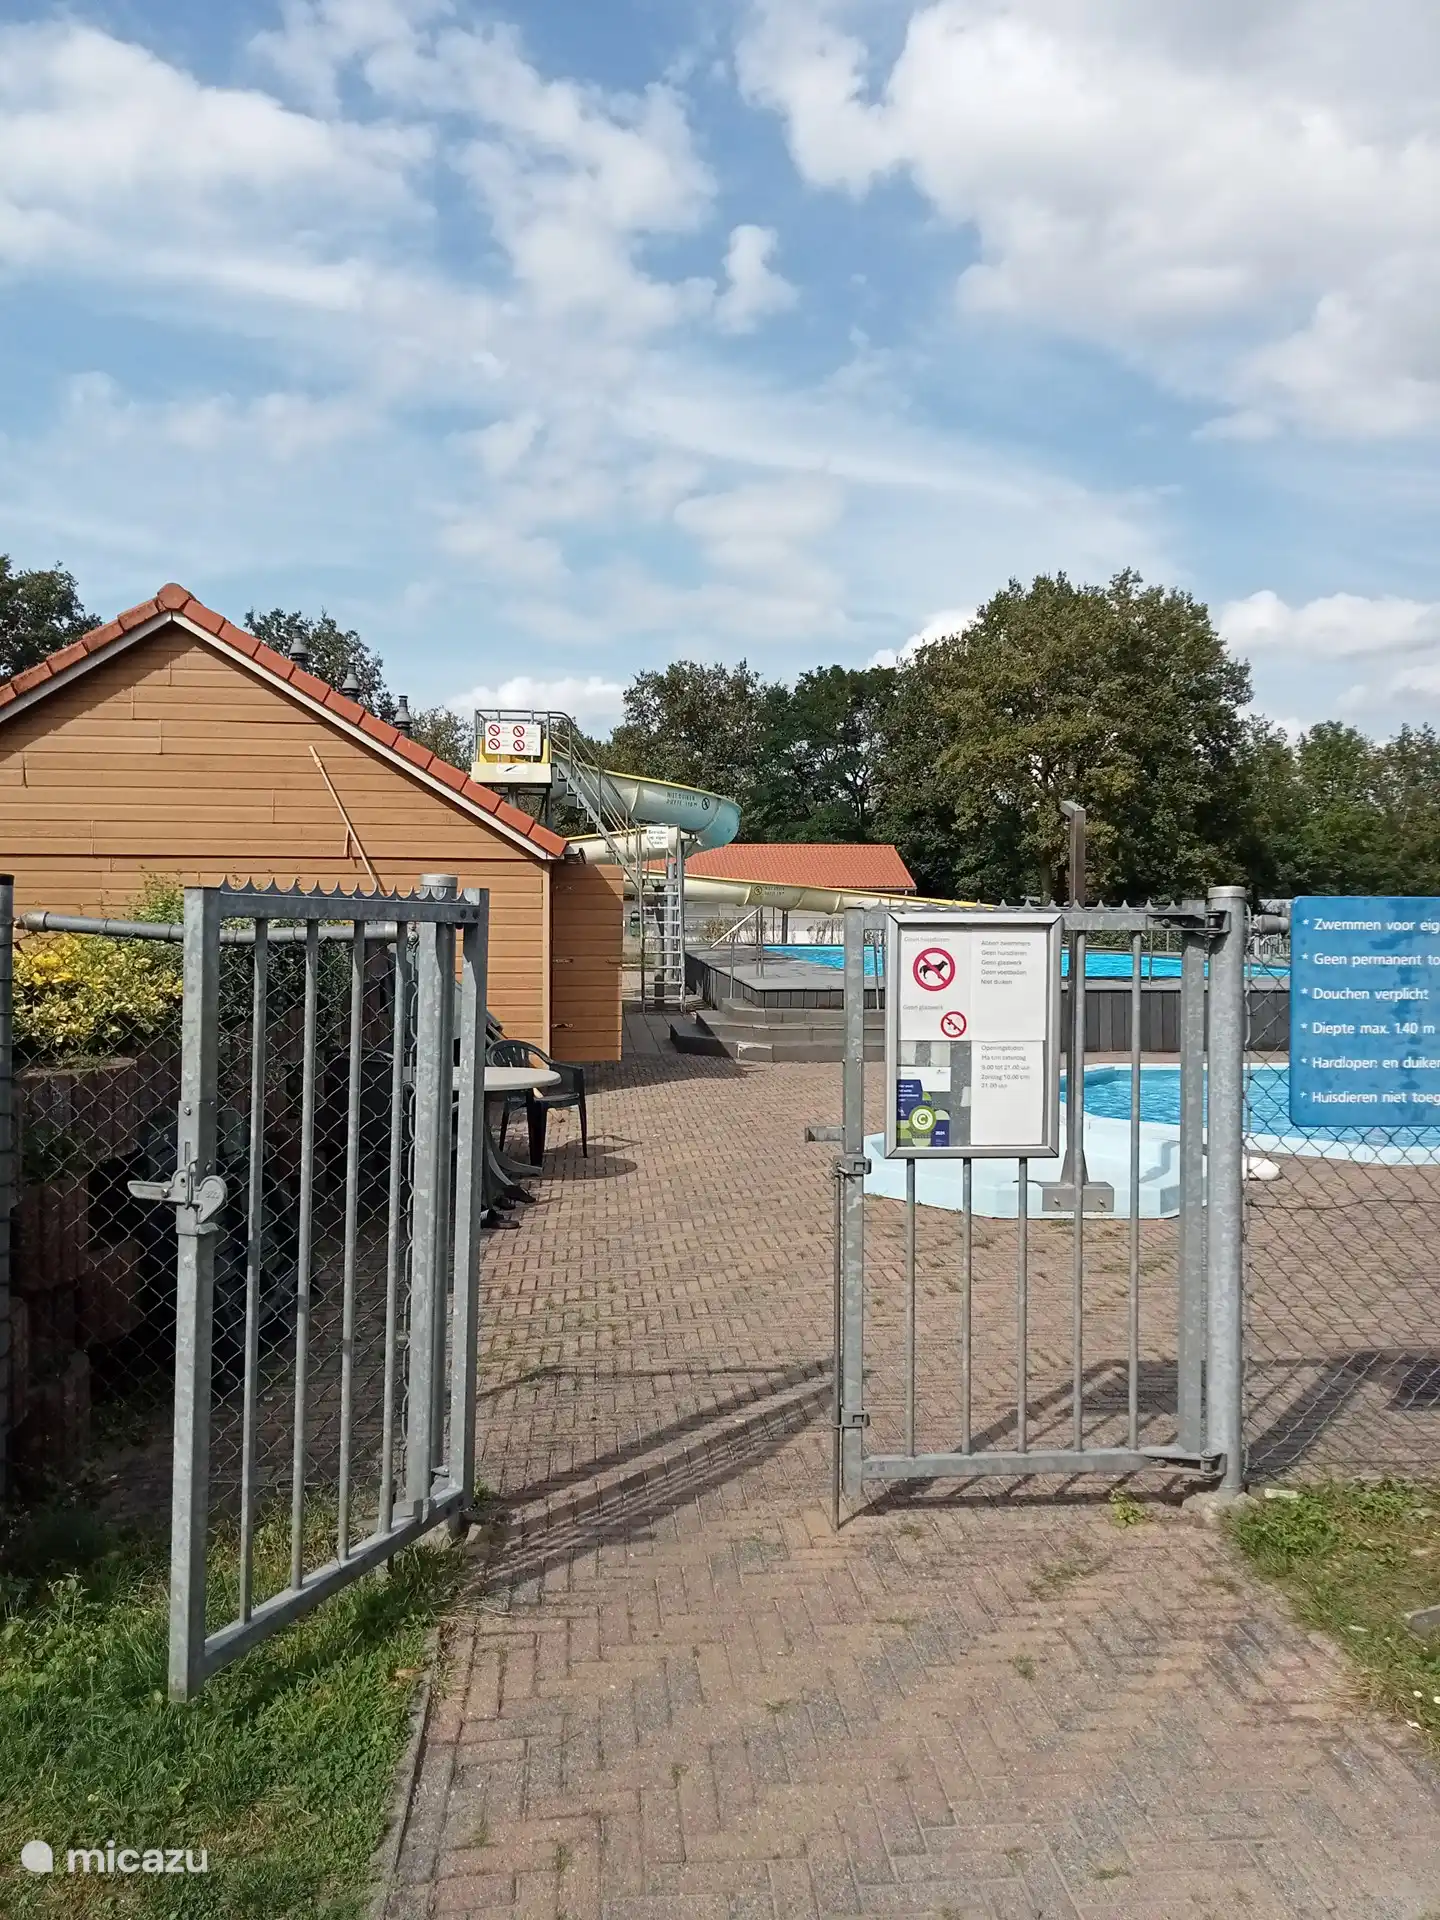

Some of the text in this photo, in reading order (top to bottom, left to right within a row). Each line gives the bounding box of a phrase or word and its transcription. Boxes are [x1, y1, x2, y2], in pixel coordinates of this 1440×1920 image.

[1313, 918, 1440, 934] Zwemmen voor eig
[1313, 952, 1440, 968] Geen permanent to
[1312, 986, 1429, 1002] Douchen verplicht
[1312, 1021, 1355, 1036] Diepte
[1359, 1024, 1390, 1034] max.
[1423, 1024, 1435, 1034] m
[1312, 1056, 1378, 1071] Hardlopen
[1382, 1058, 1399, 1069] en
[1312, 1090, 1440, 1106] Huisdieren niet toeg
